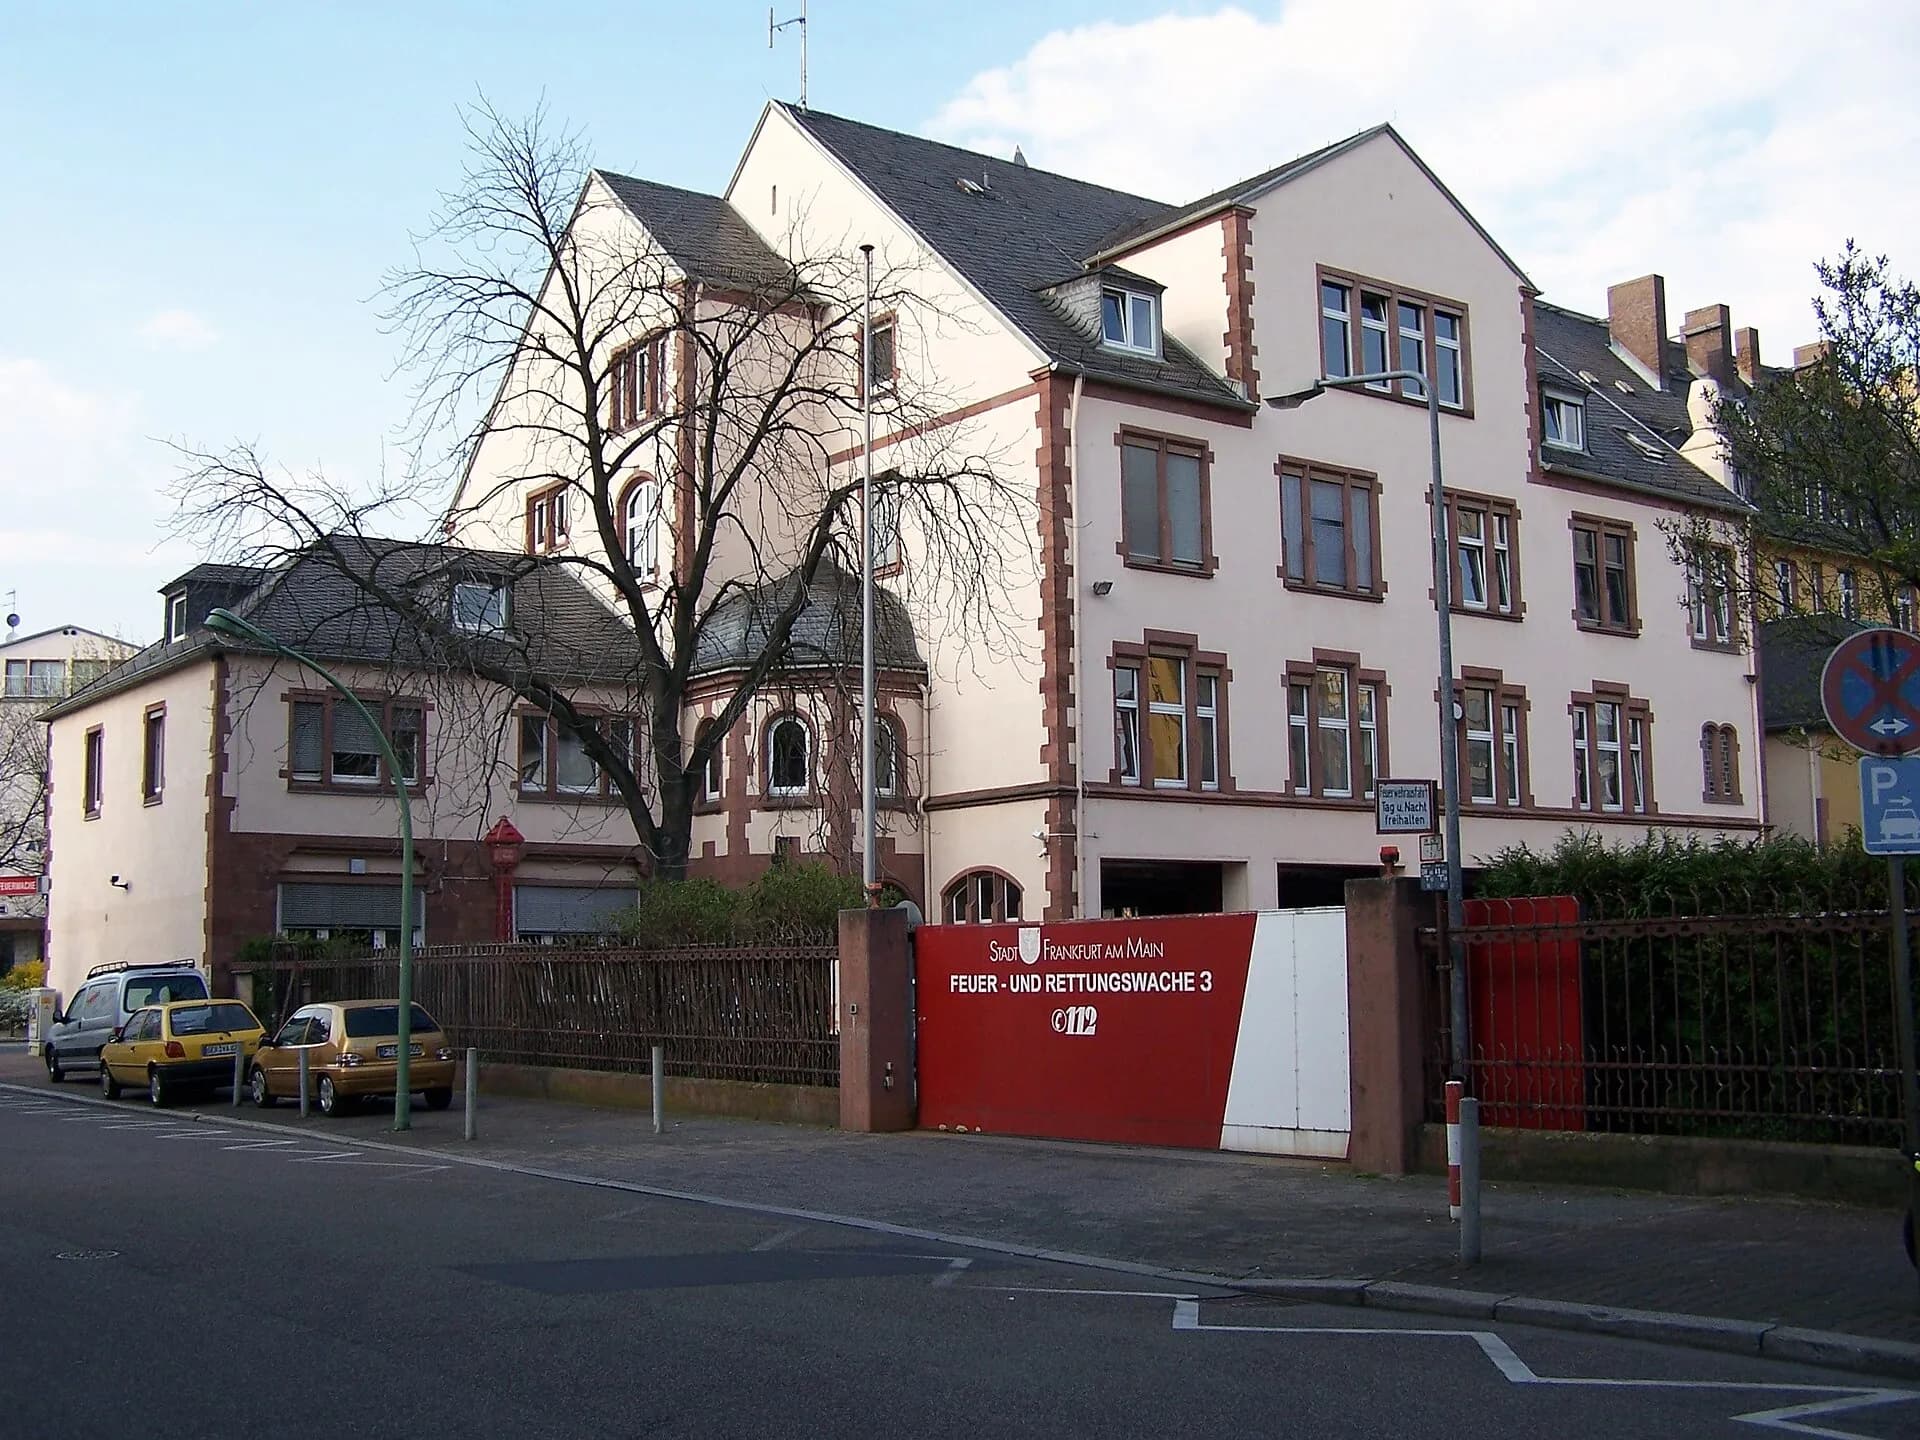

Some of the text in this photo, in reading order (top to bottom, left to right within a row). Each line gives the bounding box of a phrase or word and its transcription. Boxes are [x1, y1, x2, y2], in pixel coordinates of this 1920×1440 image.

[1871, 767, 1897, 805] P
[1382, 801, 1395, 815] Tag
[1404, 800, 1427, 812] Nacht
[1385, 814, 1425, 825] freihalten
[1045, 972, 1195, 992] RETTUNGSWACHE
[1199, 971, 1212, 991] 3
[1065, 1006, 1097, 1035] 112
